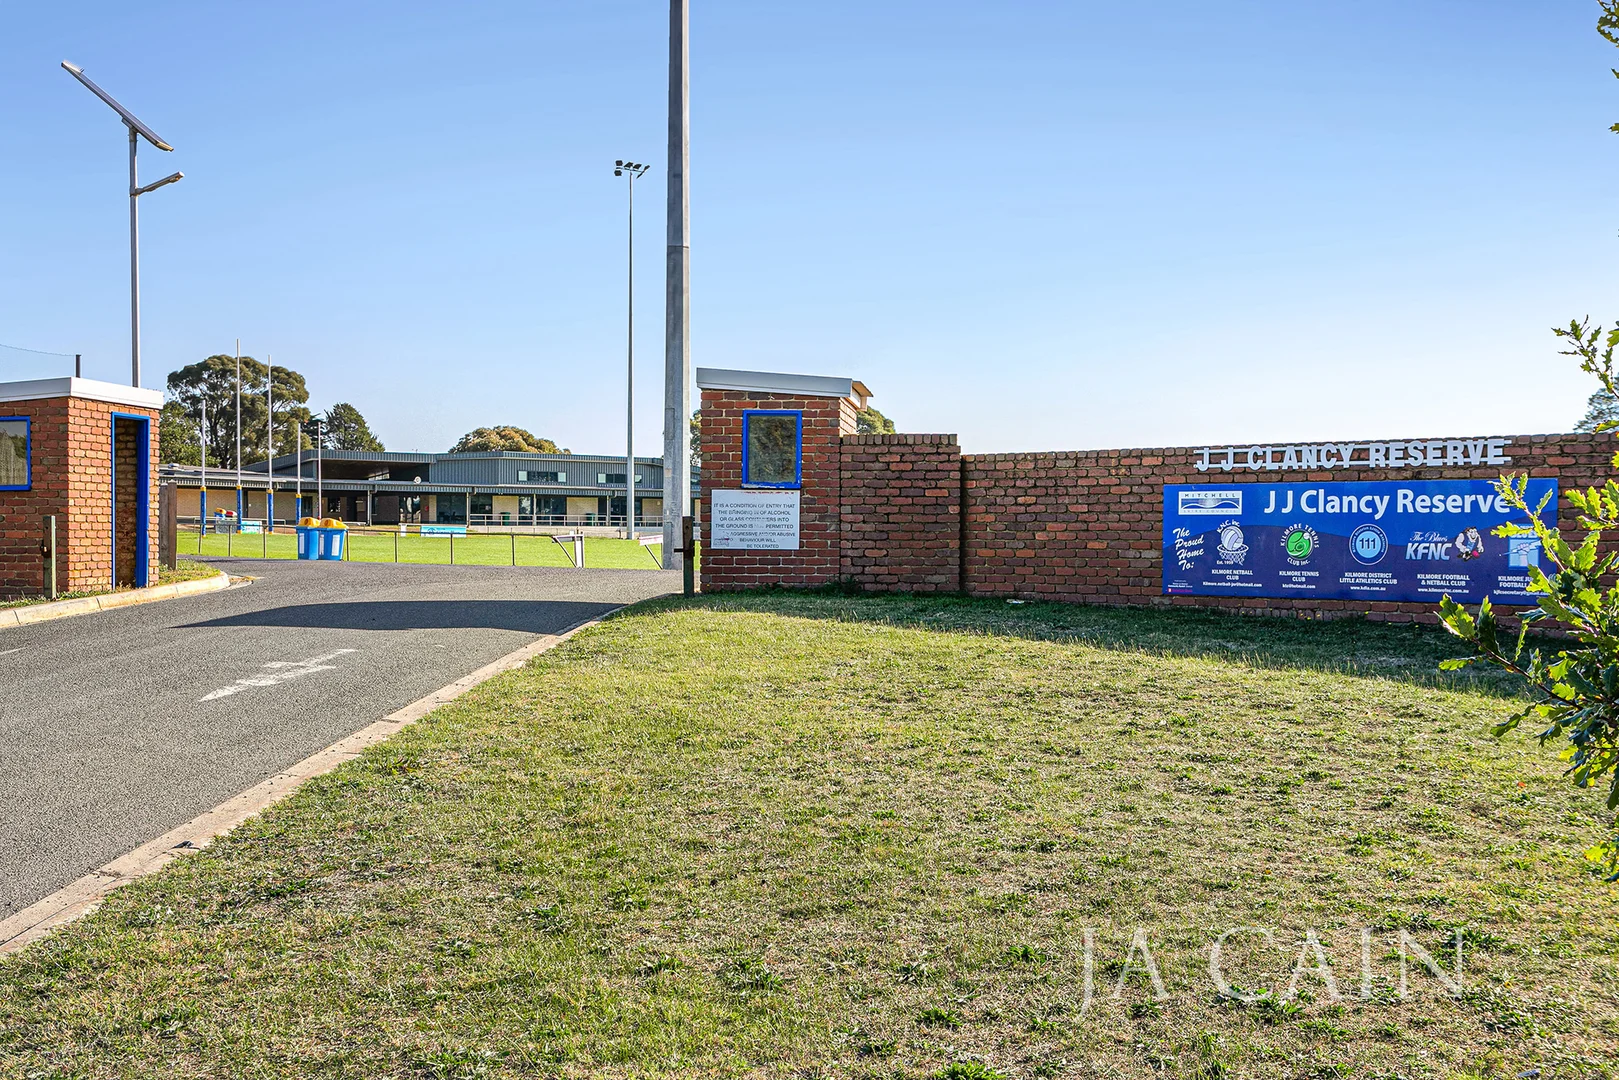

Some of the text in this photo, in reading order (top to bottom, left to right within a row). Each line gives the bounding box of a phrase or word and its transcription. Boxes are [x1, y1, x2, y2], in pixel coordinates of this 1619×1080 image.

[1196, 439, 1504, 471] J J CLANCY RESERVE
[1264, 490, 1510, 520] J J Clancy Reserve
[1172, 527, 1190, 538] The
[1280, 523, 1320, 548] KILMORE TENNIS
[1410, 532, 1424, 542] The
[1175, 535, 1204, 550] Proud
[1359, 538, 1376, 549] 111
[1177, 548, 1204, 560] Home
[1406, 543, 1452, 560] KFNC
[1178, 560, 1194, 570] To:
[1287, 558, 1300, 566] CLUB
